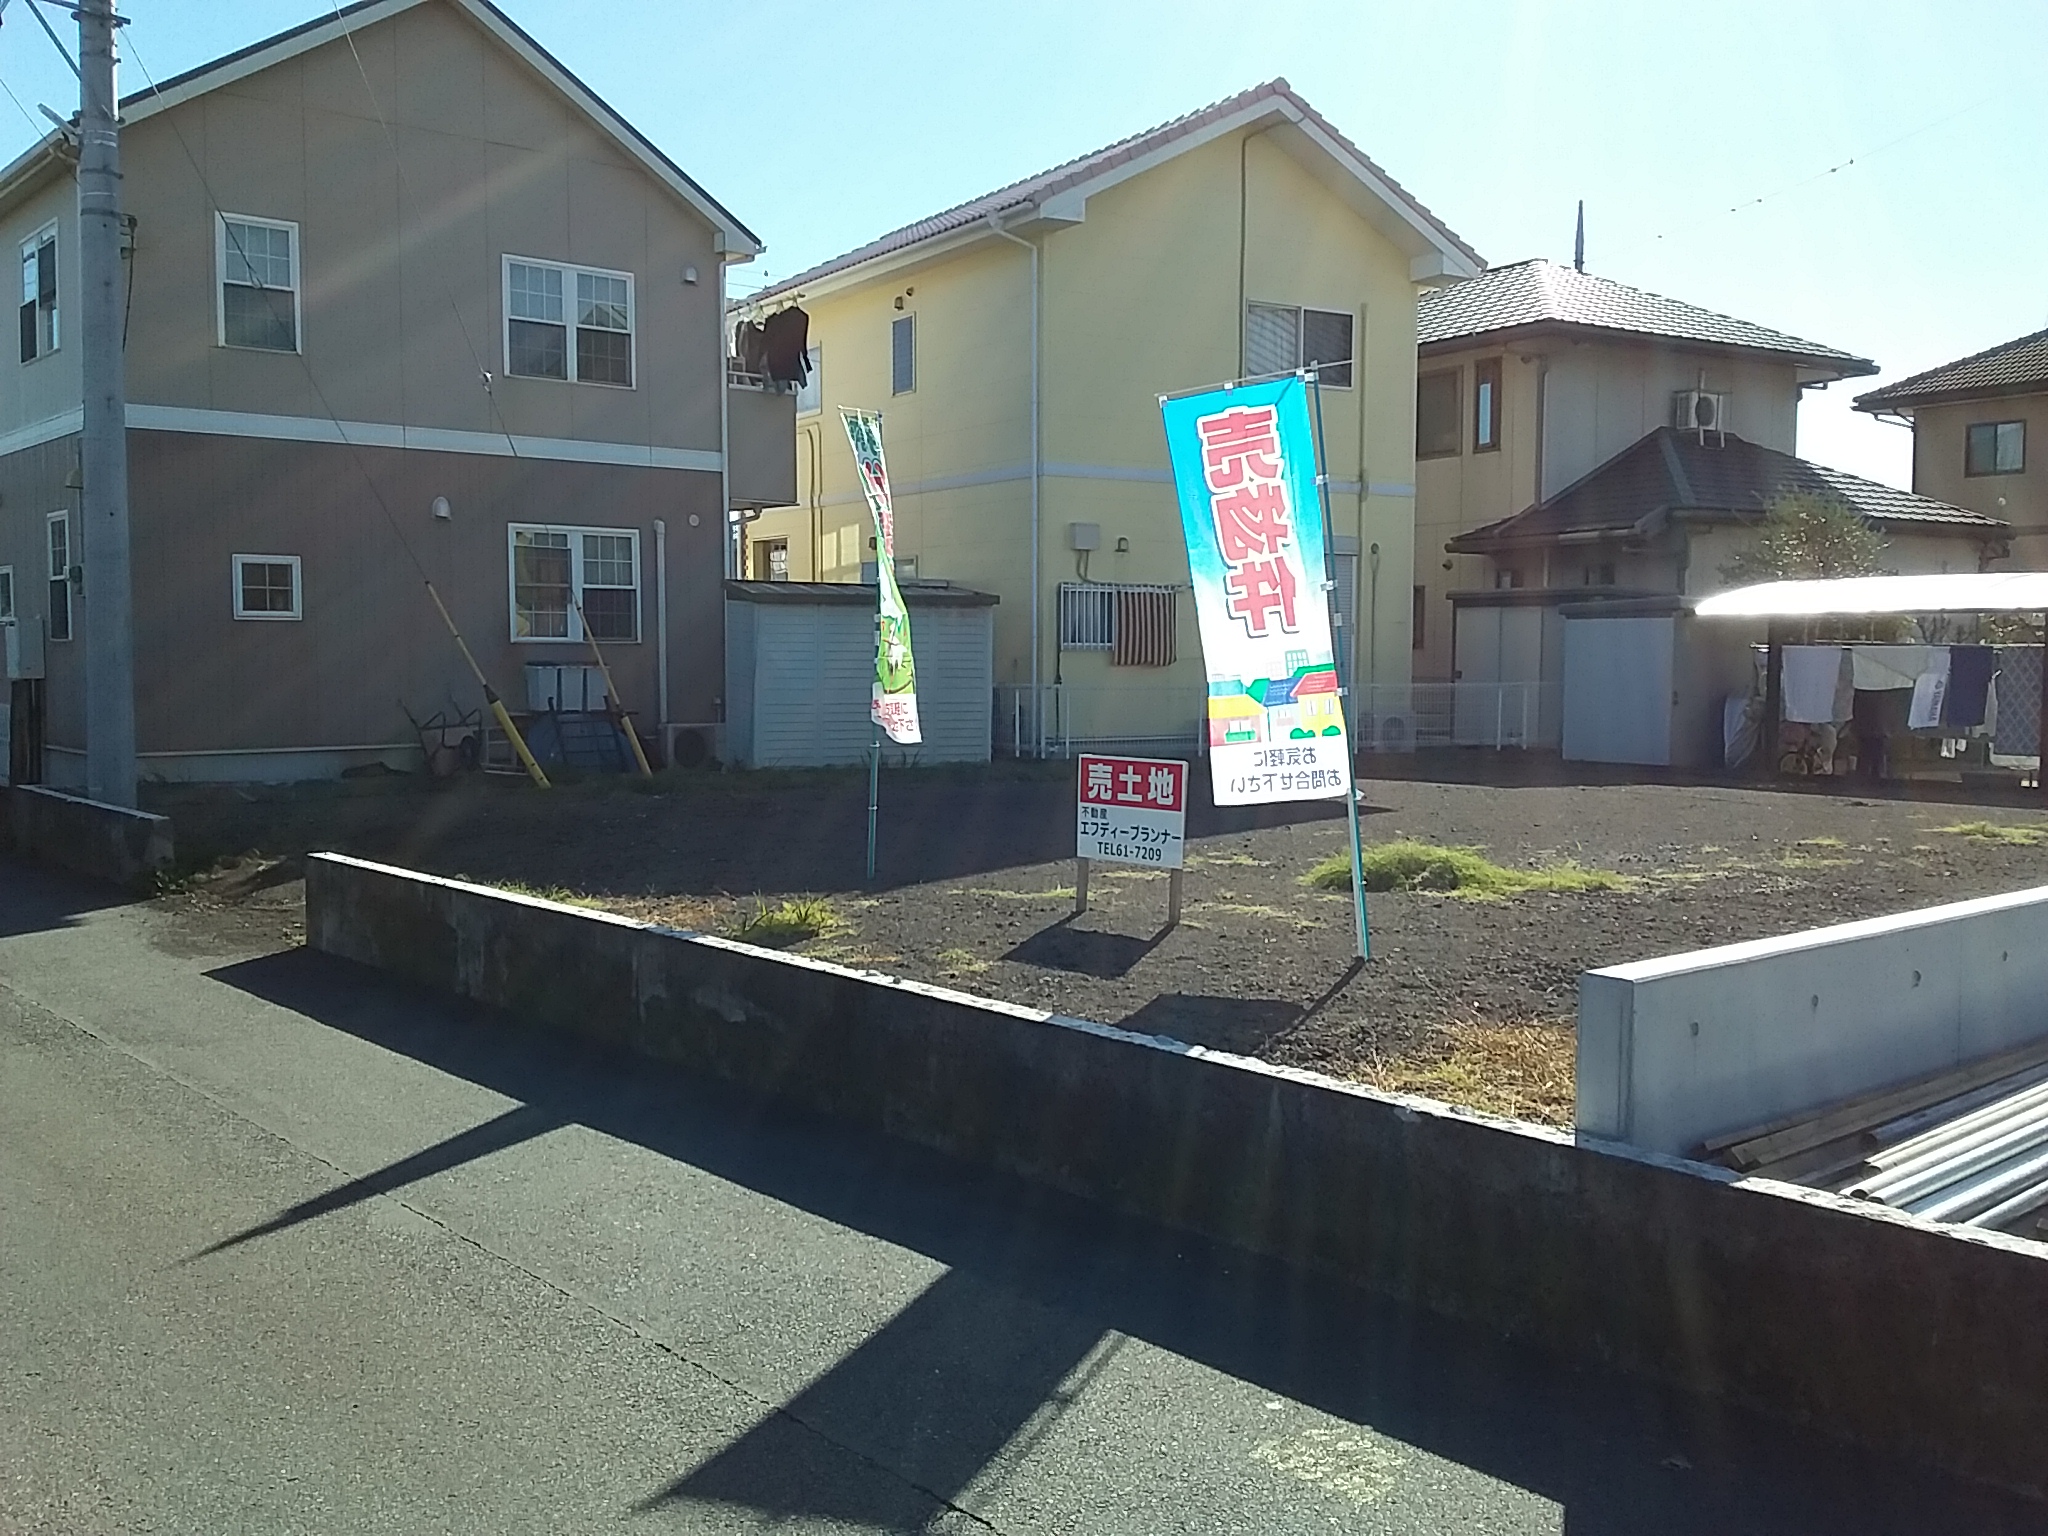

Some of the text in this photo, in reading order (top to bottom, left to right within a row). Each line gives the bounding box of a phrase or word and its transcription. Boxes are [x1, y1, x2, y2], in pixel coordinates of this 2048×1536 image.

[1087, 762, 1175, 806] 売土地
[1081, 806, 1108, 819] 不動産
[1097, 841, 1162, 862] TEL61-7209
